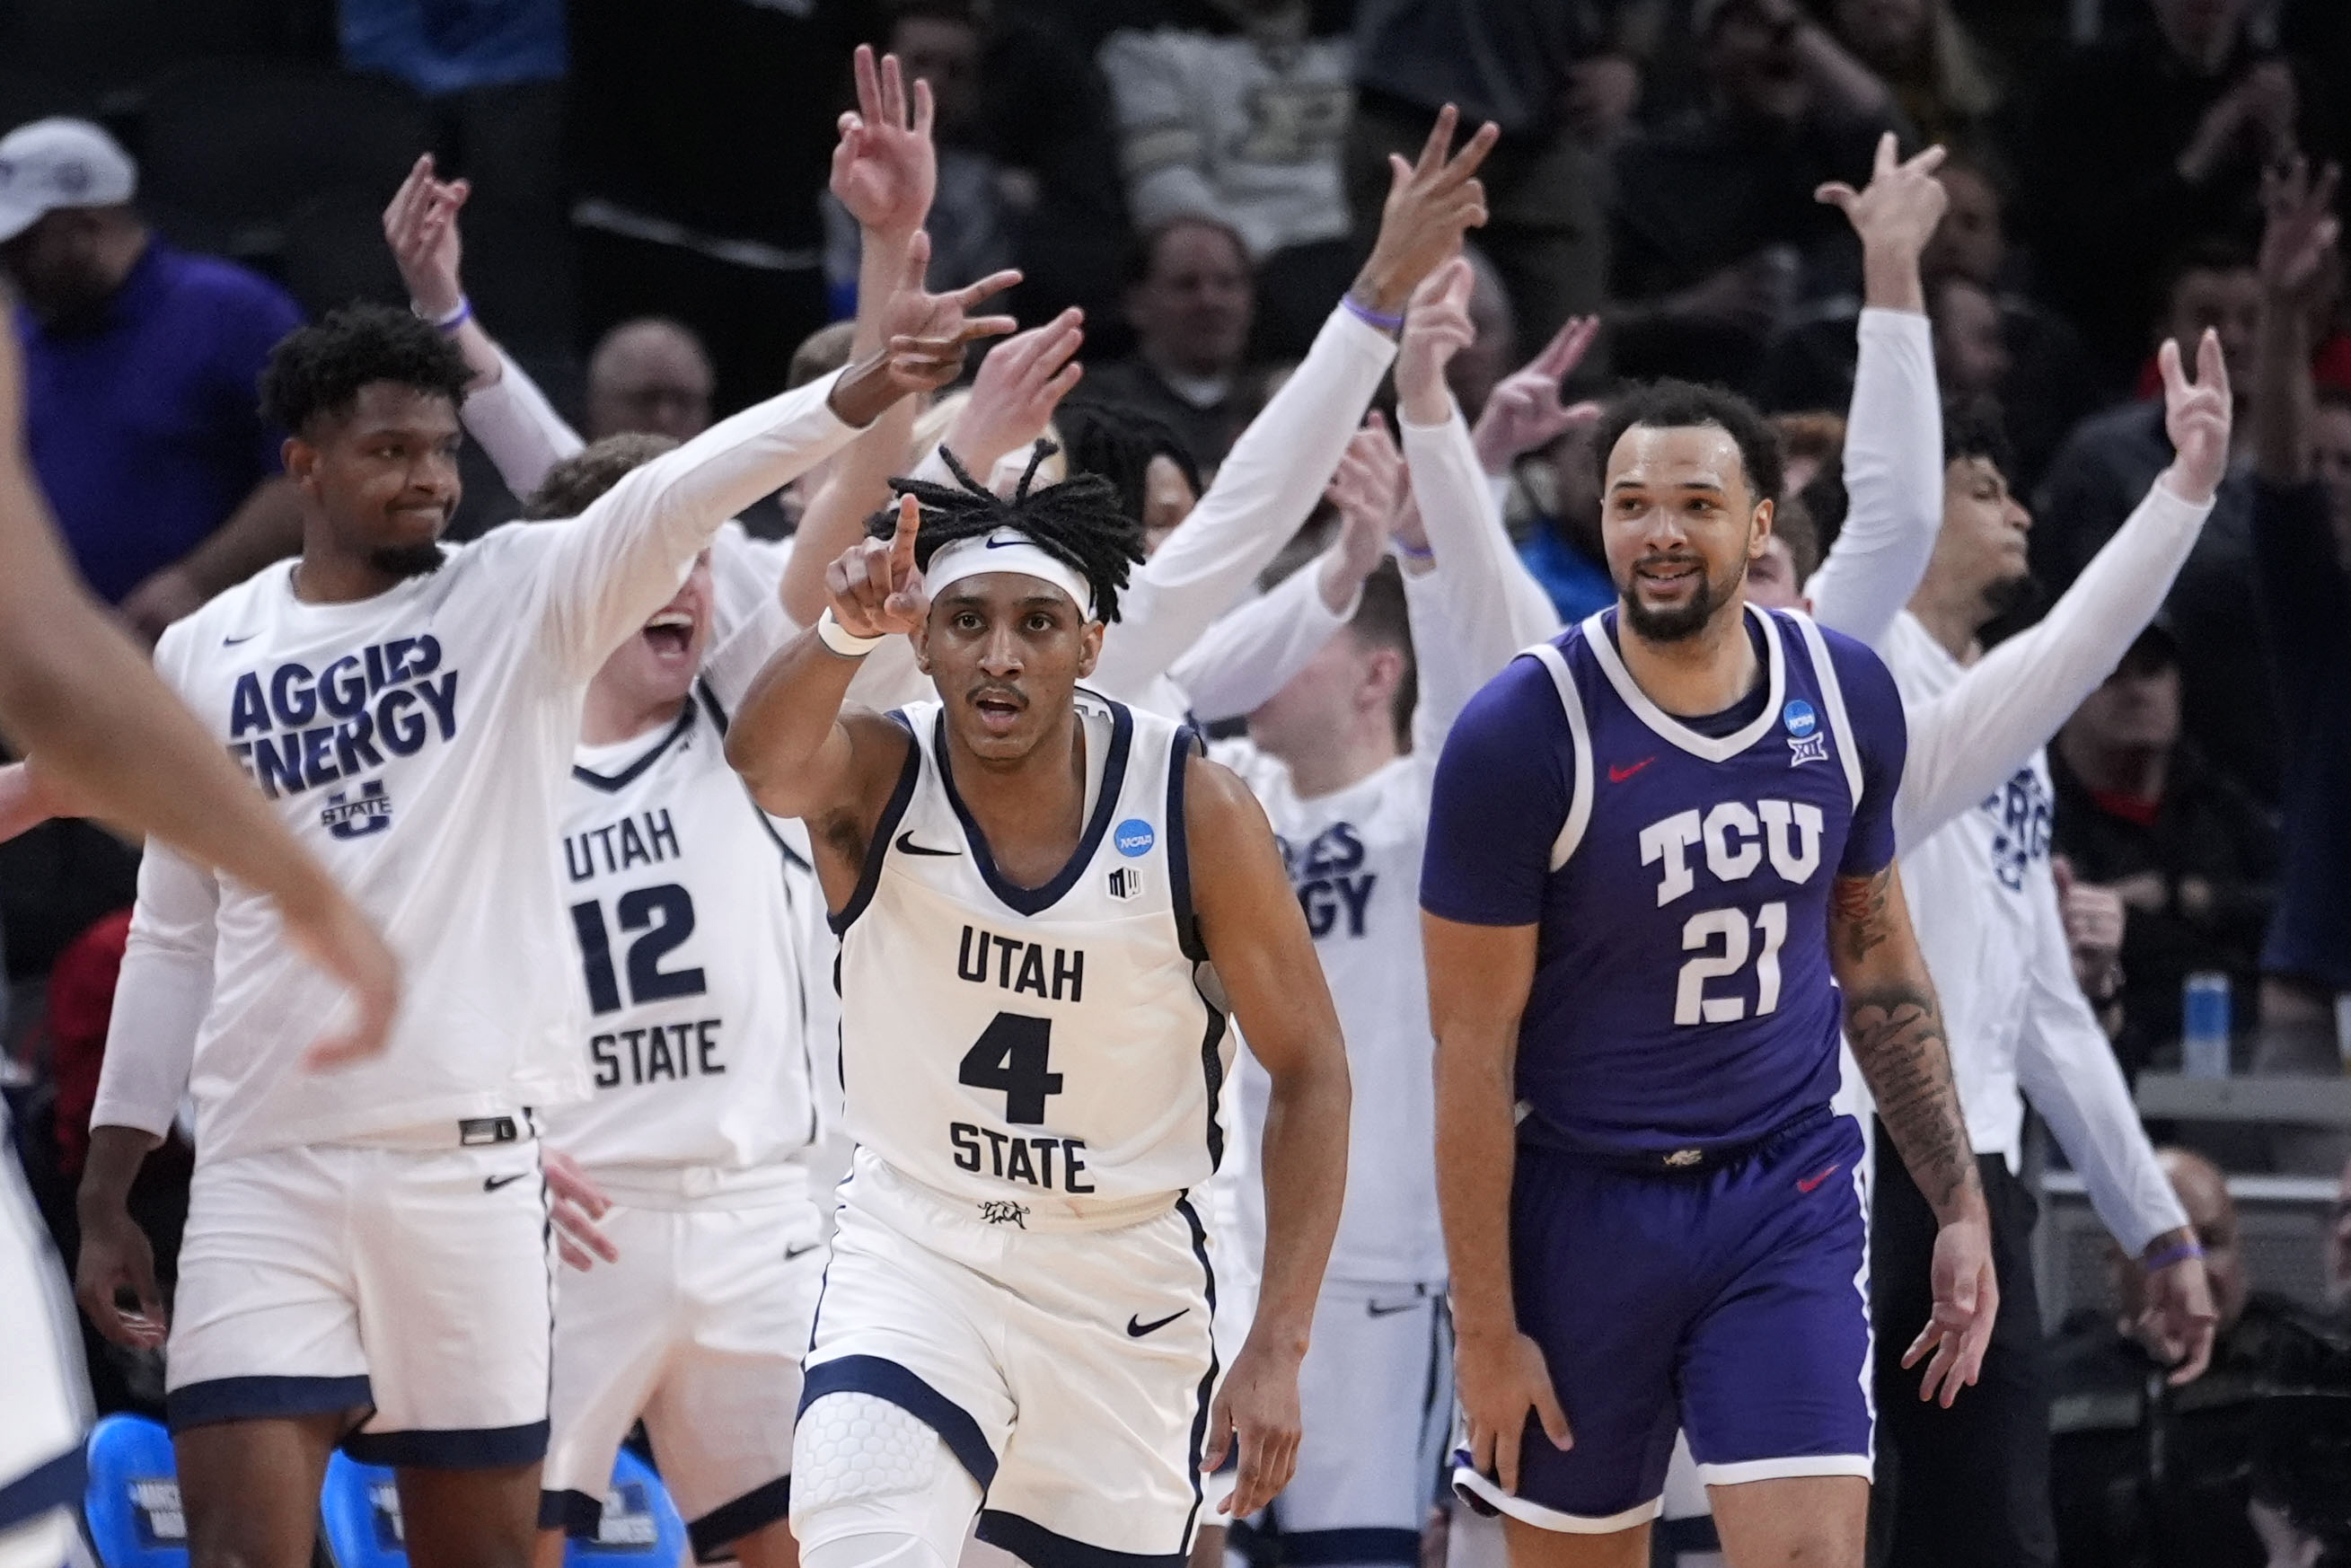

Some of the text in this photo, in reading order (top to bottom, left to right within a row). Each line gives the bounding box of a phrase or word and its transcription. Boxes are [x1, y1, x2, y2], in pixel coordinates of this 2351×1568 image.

[321, 797, 392, 826] STATE
[564, 808, 681, 883] UTAH
[1120, 833, 1153, 849] NCAA
[1639, 798, 1824, 908] TCU
[571, 884, 707, 1017] 12
[957, 925, 1084, 1002] UTAH
[1674, 902, 1787, 1026] 21
[591, 1019, 726, 1088] STATE
[959, 1011, 1063, 1125] 4
[950, 1122, 1095, 1194] STATE
